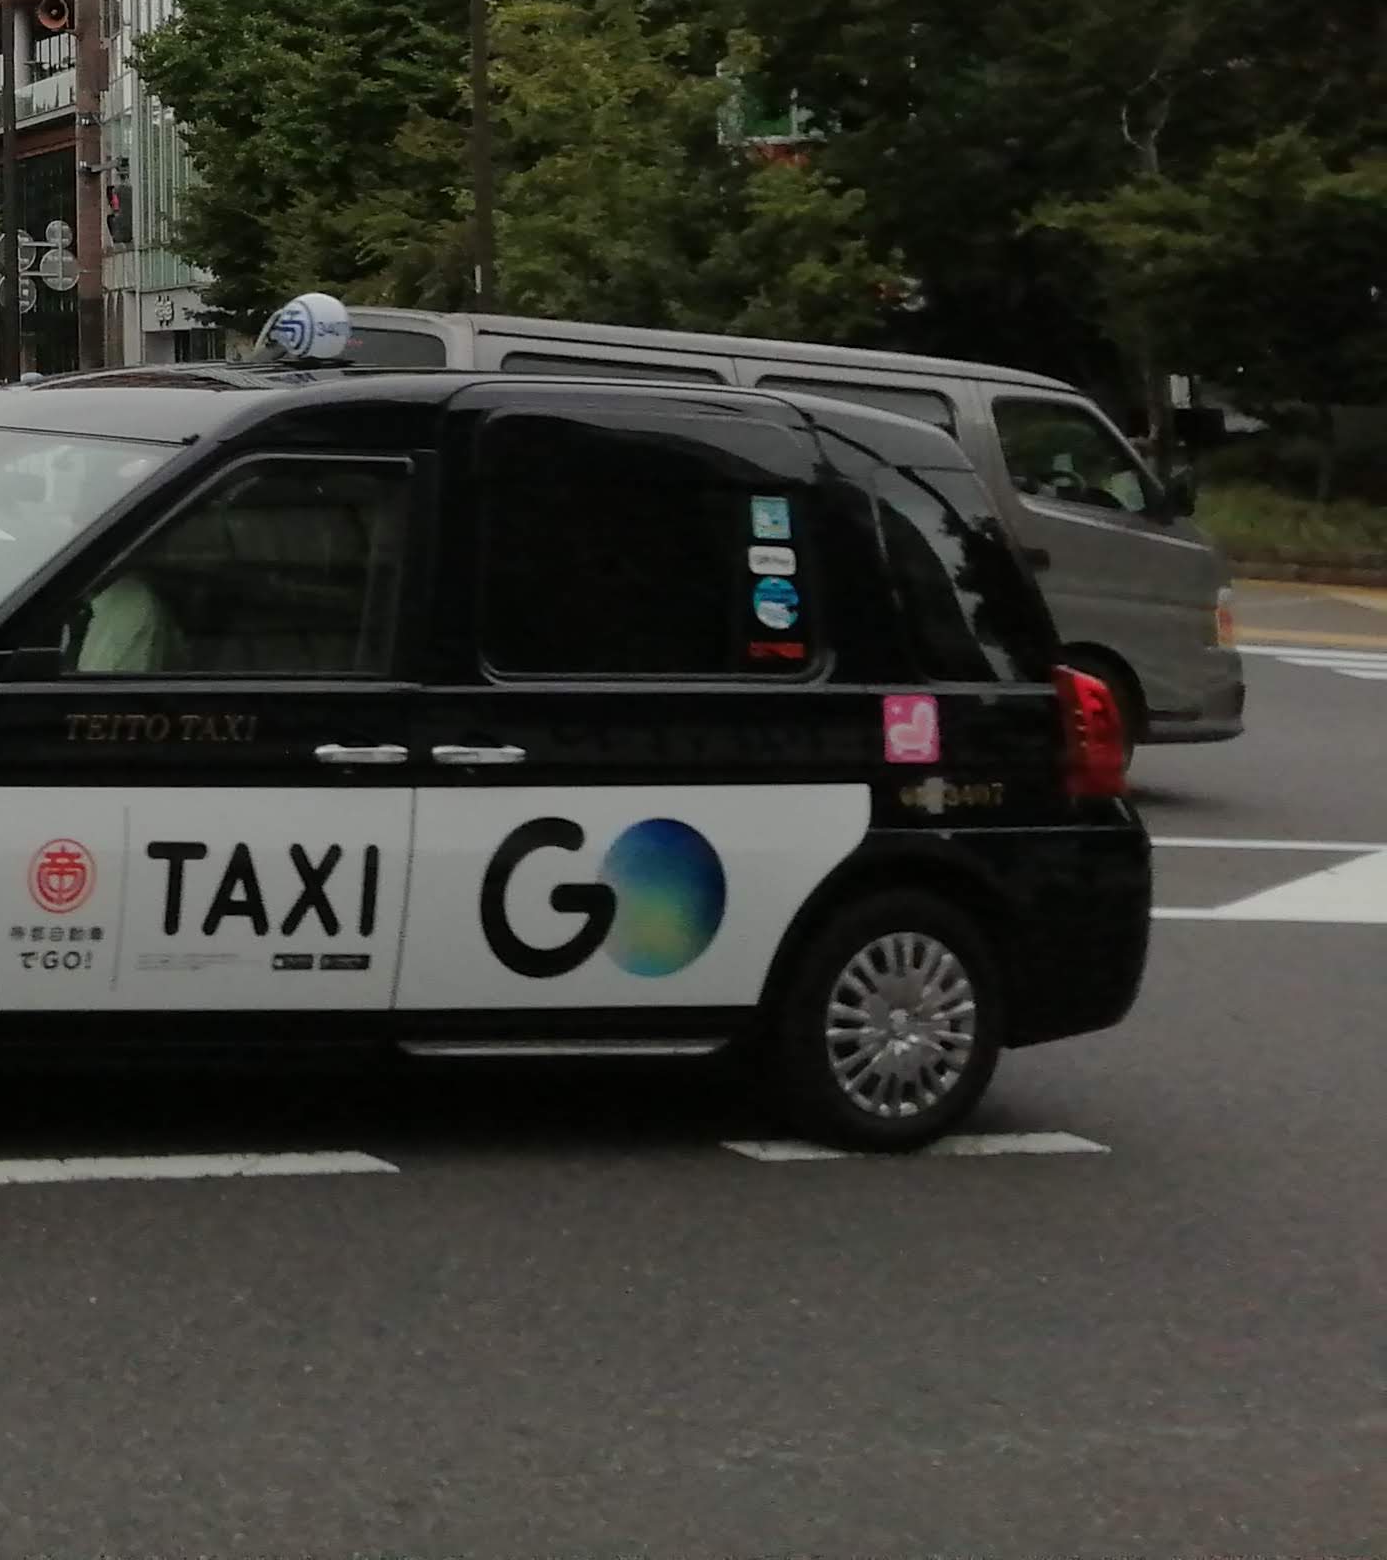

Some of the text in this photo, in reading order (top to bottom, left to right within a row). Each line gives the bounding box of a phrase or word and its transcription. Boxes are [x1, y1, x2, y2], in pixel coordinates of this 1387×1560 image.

[65, 713, 258, 741] TEITO TAXI
[147, 841, 380, 938] TAXI
[480, 817, 726, 978] GO
